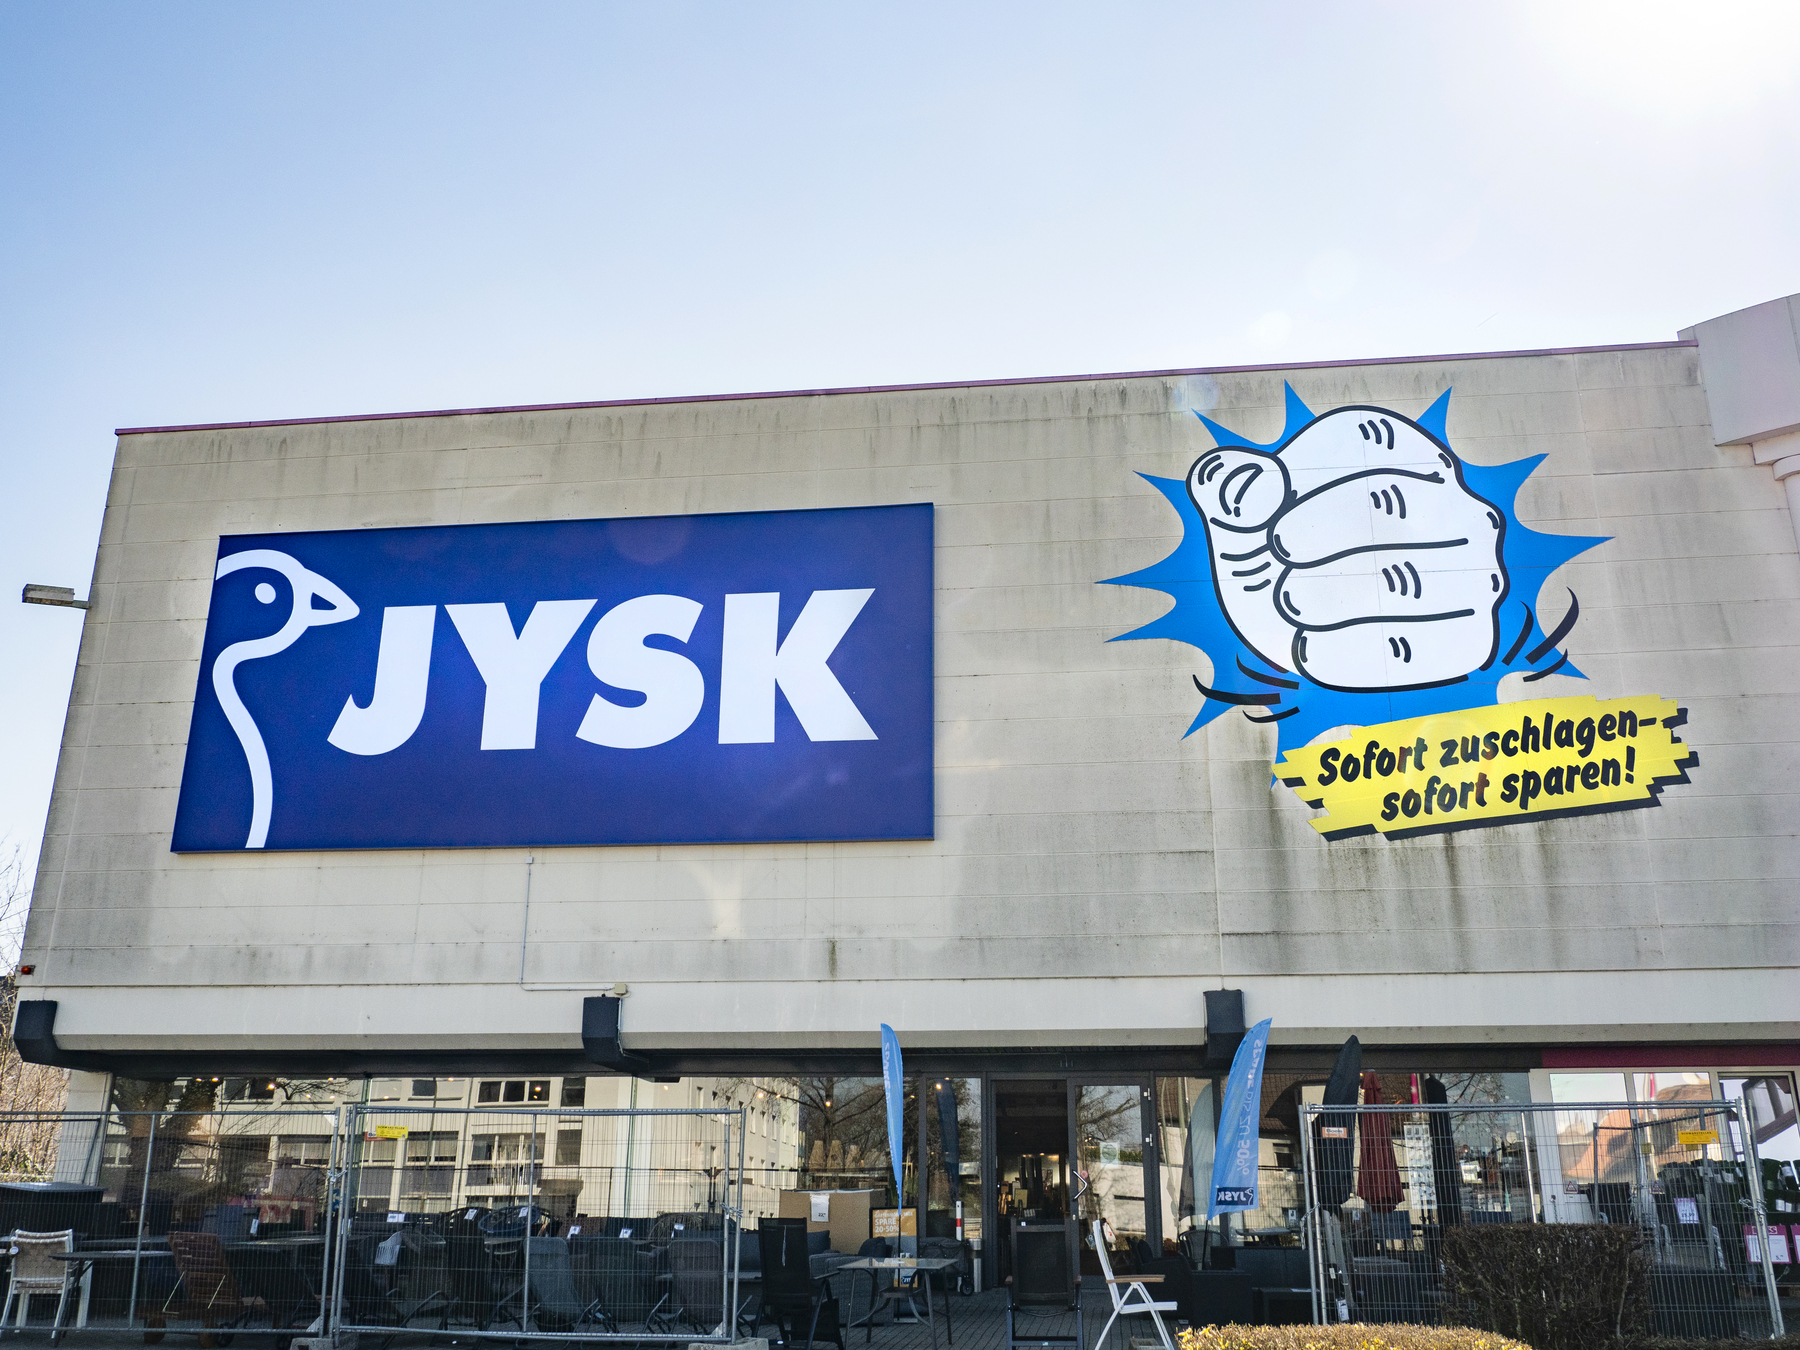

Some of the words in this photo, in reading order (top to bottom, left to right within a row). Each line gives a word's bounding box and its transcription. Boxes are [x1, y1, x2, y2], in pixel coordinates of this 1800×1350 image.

[327, 588, 879, 755] JYSK
[1318, 737, 1428, 786] Sofort
[1380, 772, 1490, 822] sofort
[1500, 746, 1636, 810] sparen!
